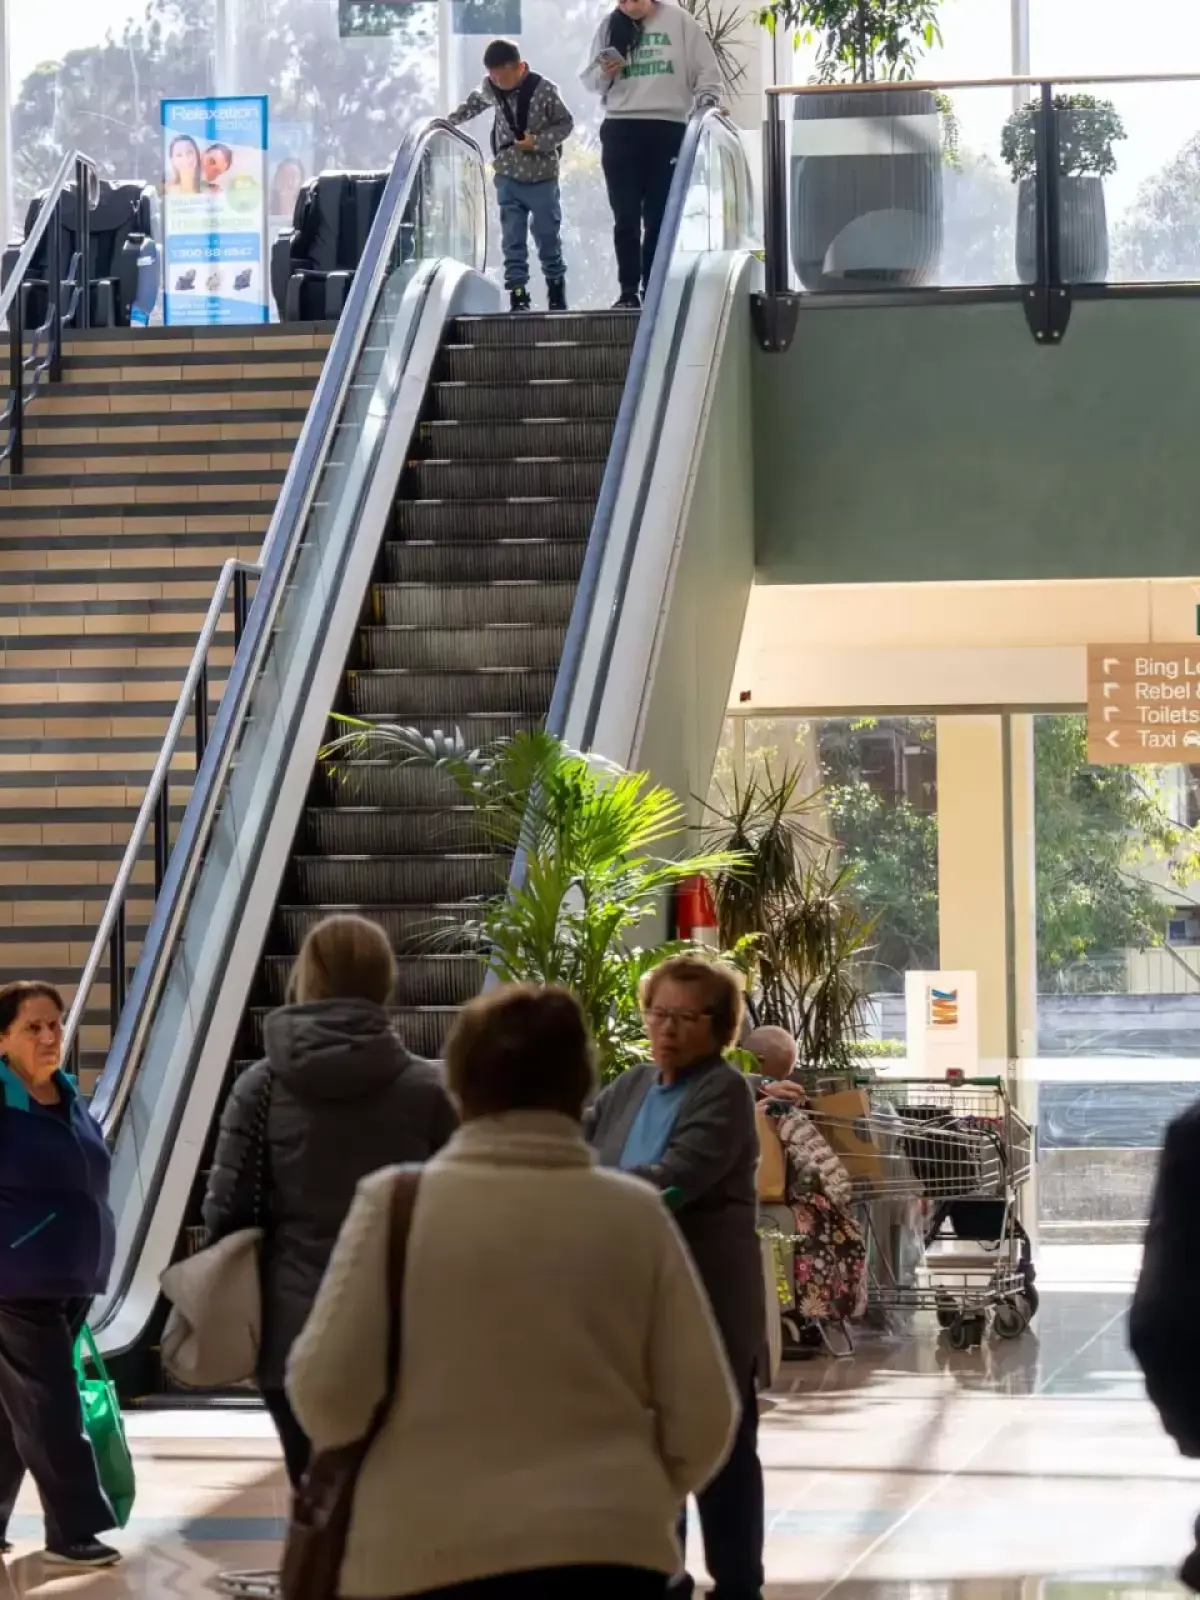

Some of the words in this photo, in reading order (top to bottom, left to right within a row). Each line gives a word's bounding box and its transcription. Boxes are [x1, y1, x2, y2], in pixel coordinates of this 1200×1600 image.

[172, 107, 258, 121] Relaxation
[1135, 656, 1178, 680] Bing
[1135, 681, 1191, 700] Rebel
[1136, 704, 1200, 725] Toilets
[1136, 730, 1176, 748] Taxi
